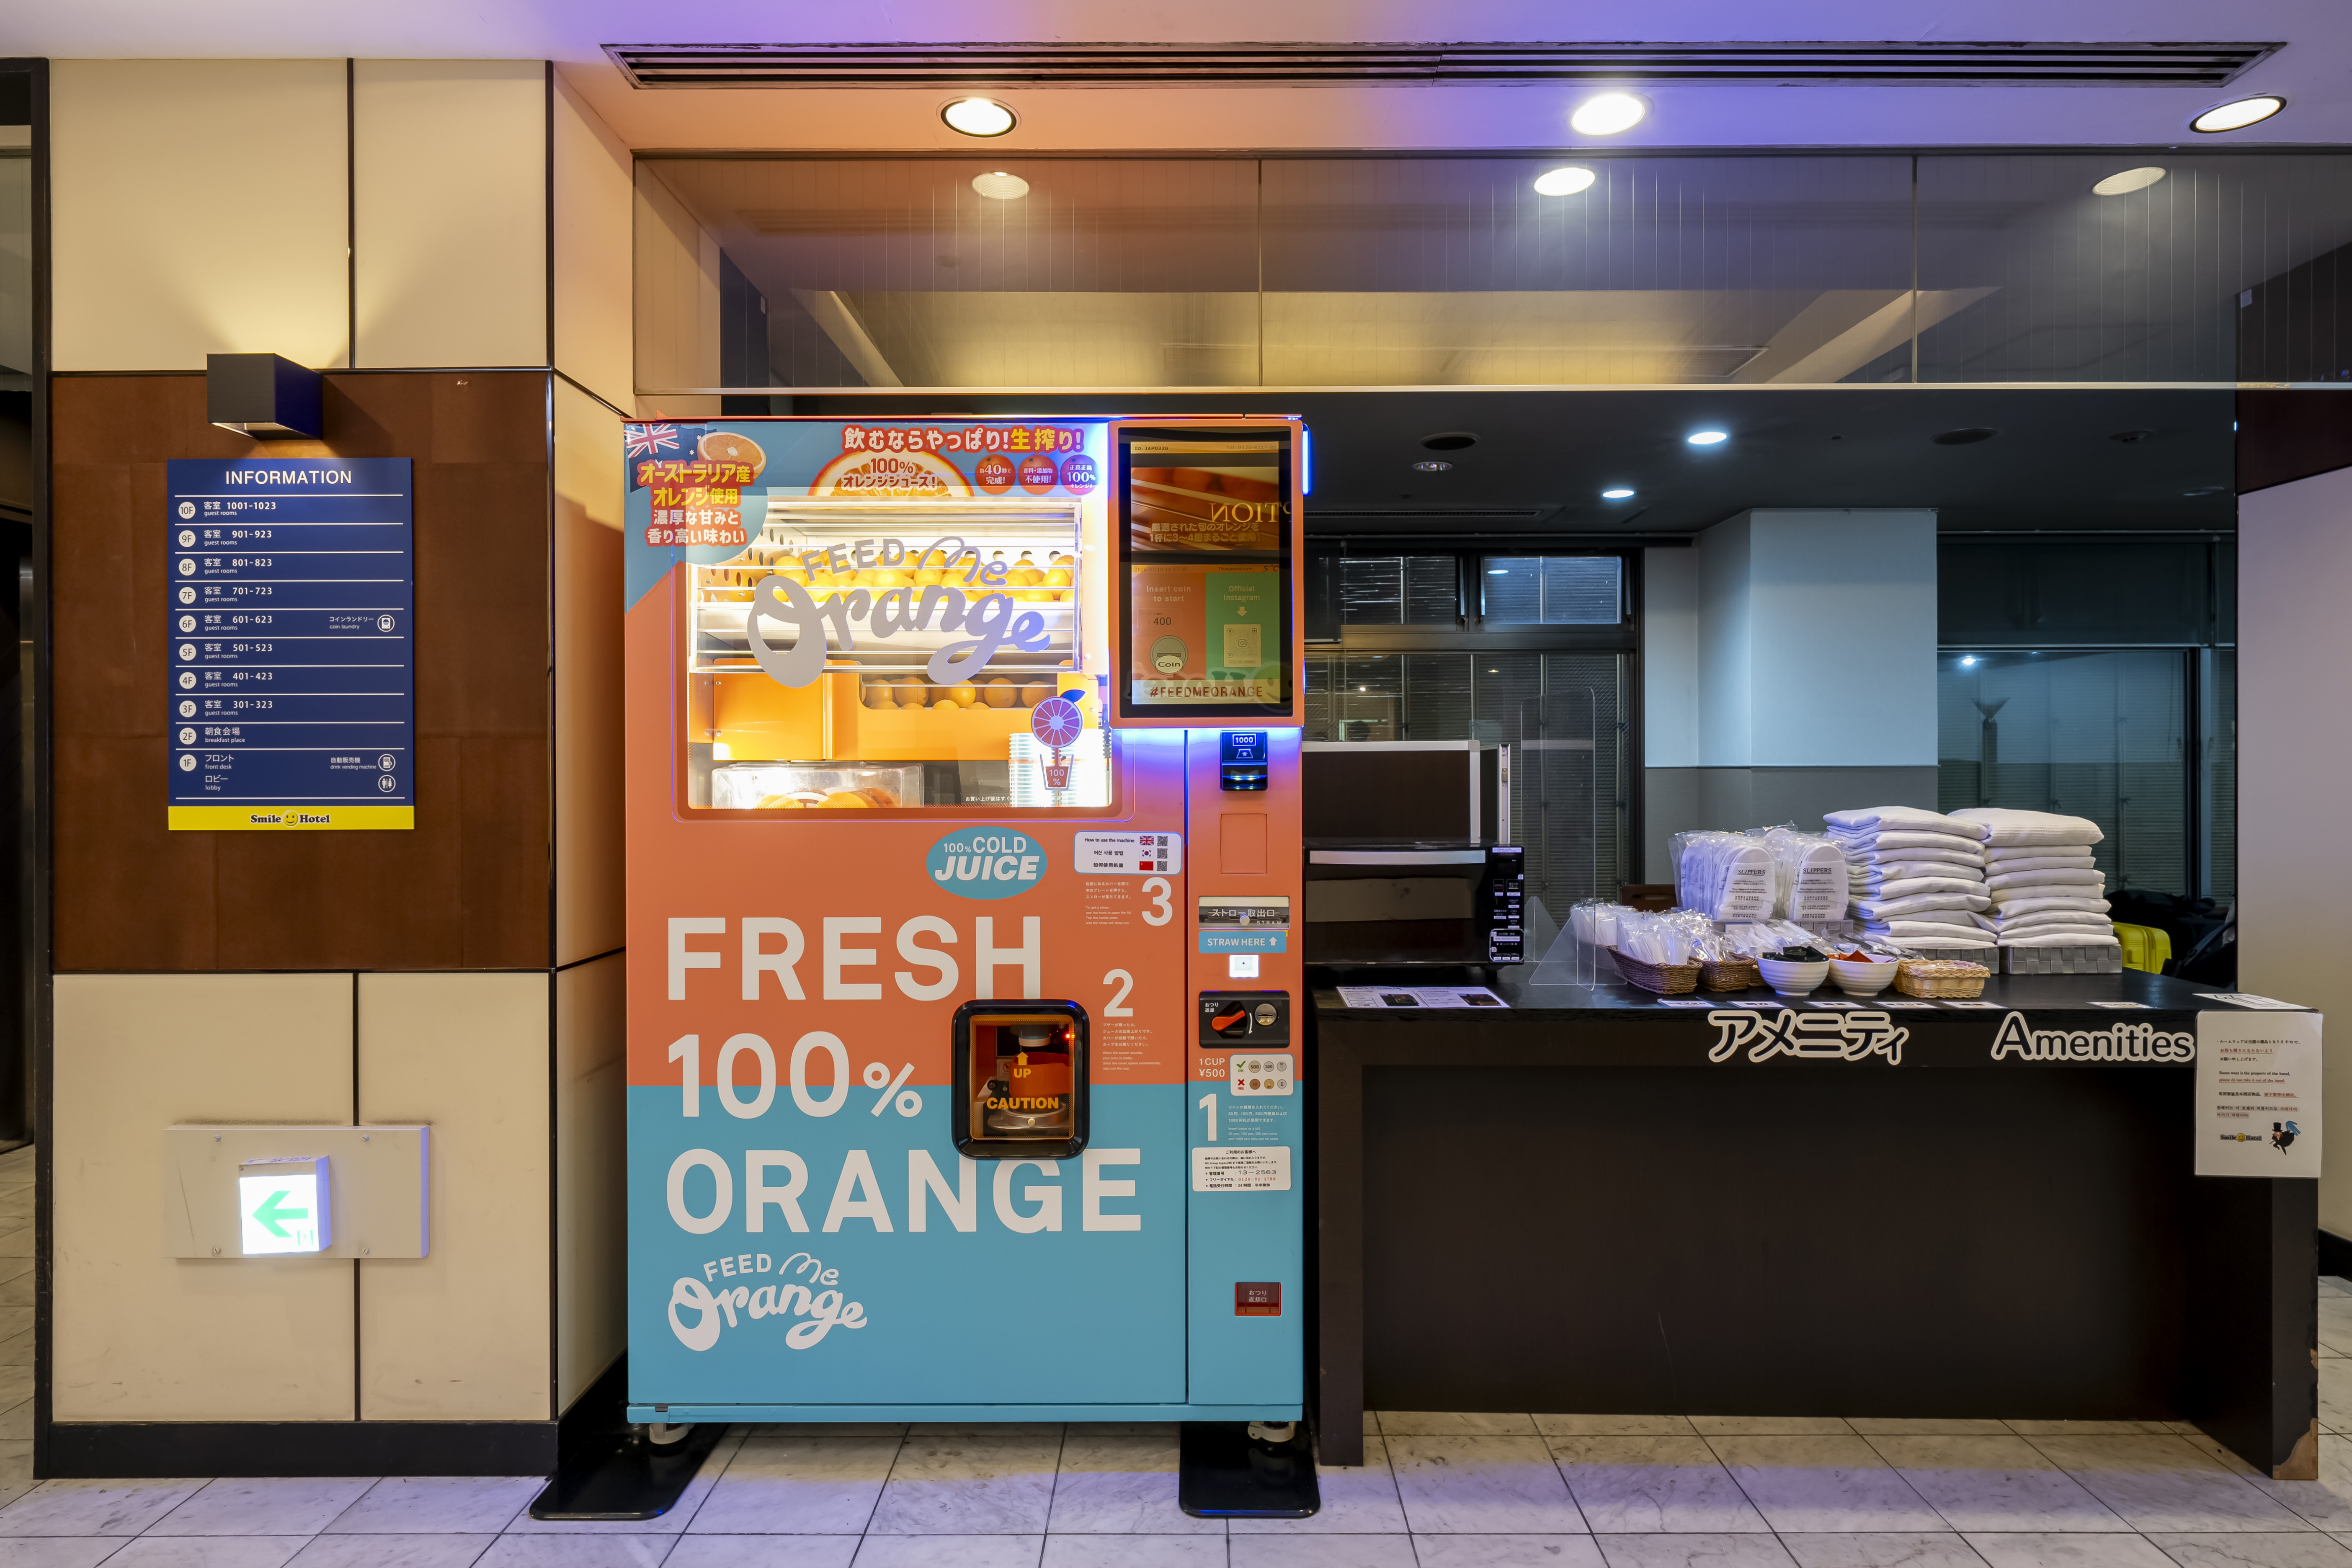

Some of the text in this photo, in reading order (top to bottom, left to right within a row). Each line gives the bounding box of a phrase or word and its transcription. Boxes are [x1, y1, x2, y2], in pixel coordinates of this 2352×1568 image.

[641, 461, 753, 485] オーストラリア産
[871, 458, 916, 473] 100%
[980, 465, 1010, 475] 約40秒で
[227, 470, 351, 484] INFORMATION
[1067, 472, 1096, 482] 100%
[654, 485, 740, 509] オレンジ使用
[653, 510, 739, 525] 濃厚な甘みと
[1152, 523, 1259, 531] 厳選された旬のオレンジを
[647, 529, 745, 544] 香り高い味わい
[204, 558, 221, 566] 客室
[799, 536, 907, 584] FEED
[205, 615, 221, 623] 客室
[747, 575, 1050, 688] Orange
[1150, 686, 1263, 697] #FEEDMEORANGE
[205, 727, 240, 735] 朝食会場
[250, 814, 331, 824] Smile Hotel
[944, 837, 1026, 853] 100% COLD
[935, 856, 1039, 881] JUICE
[1142, 877, 1173, 926] 3
[668, 916, 1040, 1001] FRESH
[1103, 969, 1133, 1017] 2
[1708, 1009, 1909, 1065] アメニティ
[1991, 1011, 2195, 1062] Amenities
[668, 1031, 922, 1119] 100%
[1014, 1068, 1031, 1078] UP
[987, 1097, 1059, 1109] CAUTION
[1199, 1093, 1217, 1141] 1
[667, 1148, 1141, 1234] ORANGE
[704, 1254, 771, 1282] FEED
[668, 1277, 867, 1351] Orange
